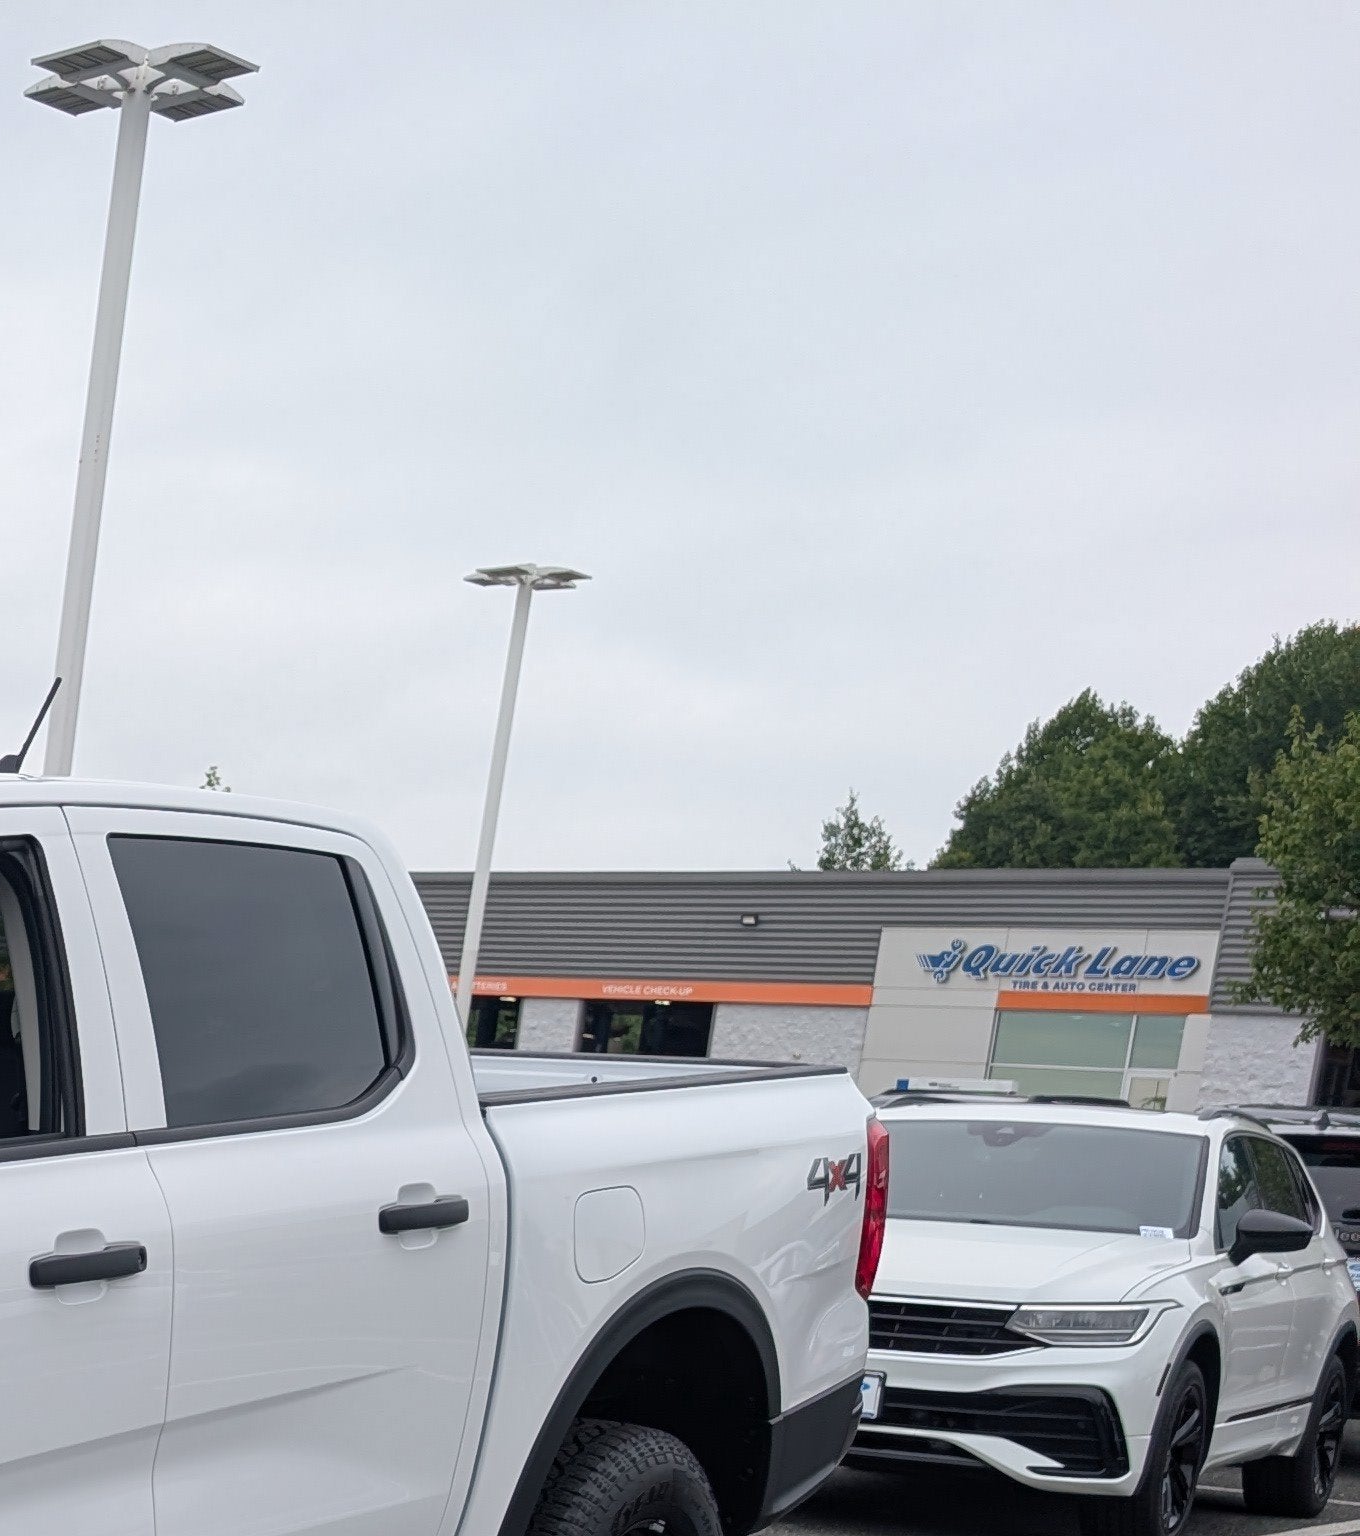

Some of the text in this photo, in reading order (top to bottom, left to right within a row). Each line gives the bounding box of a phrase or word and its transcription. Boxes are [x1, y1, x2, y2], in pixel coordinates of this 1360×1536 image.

[961, 944, 1200, 981] Quick Lane
[602, 984, 693, 996] VEHICLE CHECK-UP
[1011, 980, 1137, 993] TIRE & AUTO CENTER
[1335, 1227, 1360, 1241] Jee
